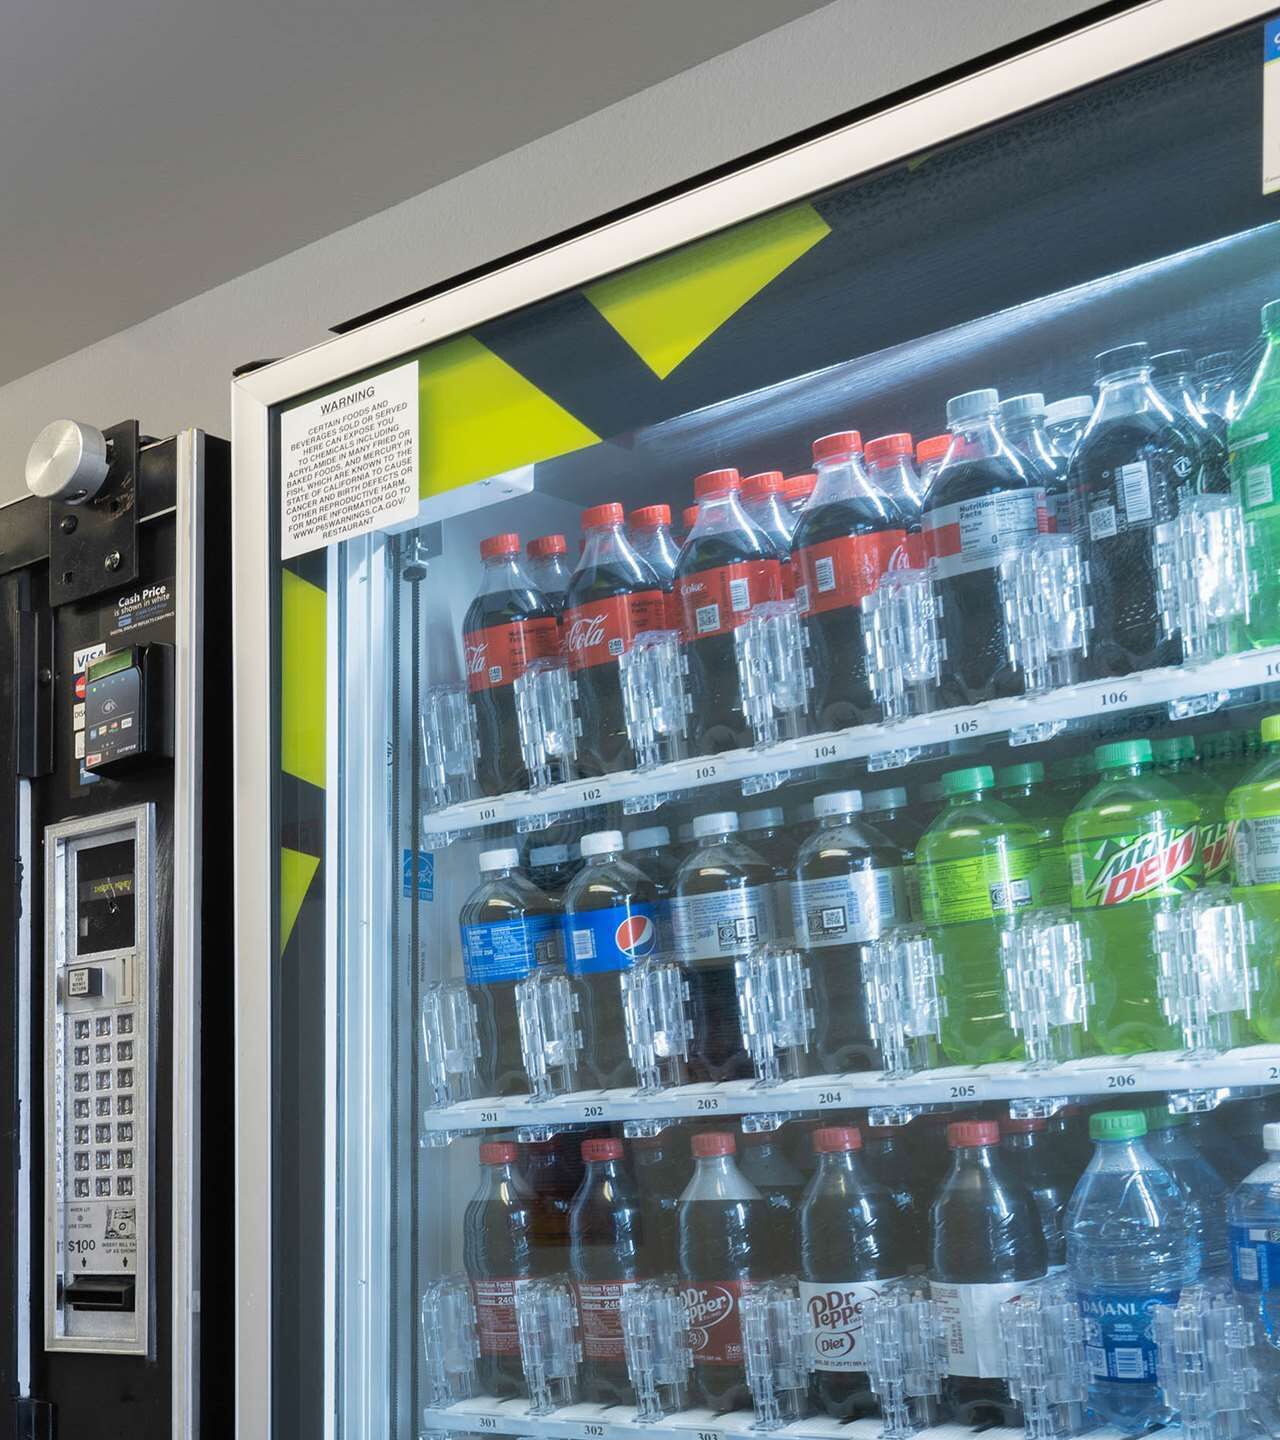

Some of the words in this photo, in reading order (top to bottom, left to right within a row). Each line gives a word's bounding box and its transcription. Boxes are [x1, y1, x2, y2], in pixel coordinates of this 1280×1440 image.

[320, 385, 375, 416] WARNING
[308, 417, 340, 436] CERTAIN
[342, 406, 369, 423] FOODS
[371, 399, 388, 412] AND
[290, 427, 336, 451] BEVERAGES
[339, 419, 359, 433] SOLD
[361, 414, 372, 425] OR
[375, 401, 407, 419] SERVED
[303, 442, 322, 455] HERE
[325, 435, 341, 447] CAN
[344, 423, 374, 440] EXPOSE
[377, 416, 393, 428] YOU
[298, 457, 307, 466] TO
[310, 440, 354, 462] CHEMICALS
[356, 423, 398, 445] INCLUDING
[288, 455, 336, 479] ACRYLAMIDE
[339, 452, 346, 460] IN
[349, 443, 370, 457] MANY
[373, 433, 396, 448] FRIED
[398, 428, 409, 439] OR
[287, 473, 312, 489] BAKED
[345, 455, 360, 468] AND
[363, 441, 401, 461] MERCURY
[405, 437, 412, 446] IN
[307, 475, 332, 490] WHICH
[334, 469, 349, 480] ARE
[352, 457, 380, 474] KNOWN
[384, 453, 393, 463] TO
[397, 446, 411, 458] THE
[286, 492, 308, 507] STATE
[311, 488, 320, 498] OF
[323, 471, 369, 494] CALIFORNIA
[372, 466, 382, 476] TO
[384, 456, 411, 472] CAUSE
[286, 498, 316, 515] CANCER
[319, 492, 334, 504] AND
[337, 483, 359, 497] BIRTH
[362, 470, 398, 489] DEFECTS
[401, 465, 412, 475] OR
[289, 521, 303, 533] FOR
[306, 513, 327, 527] MORE
[329, 494, 382, 519] INFORMATION
[385, 489, 396, 499] GO
[399, 484, 410, 494] TO
[291, 507, 316, 523] OTHER
[319, 486, 378, 513] REPRODUCTIVE
[323, 516, 373, 539] RESTAURANT
[118, 593, 140, 607] Cash
[142, 585, 166, 600] Price
[120, 604, 143, 615] shown
[151, 593, 170, 603] white
[1101, 690, 1127, 706] 106
[954, 719, 978, 735] 105
[815, 745, 837, 758] 104
[696, 766, 716, 779] 103
[583, 788, 601, 801] 102
[479, 808, 496, 820] 101
[1108, 1074, 1135, 1088] 206
[819, 1091, 842, 1104] 204
[951, 1085, 975, 1098] 205
[584, 1106, 603, 1116] 202
[697, 1099, 718, 1110] 203
[480, 1112, 498, 1122] 201
[826, 1291, 856, 1307] Dr
[807, 1295, 864, 1329] Peppe
[1083, 1302, 1138, 1316] DASANI
[822, 1338, 845, 1353] Diet
[479, 1417, 497, 1428] 301
[584, 1425, 603, 1436] 302
